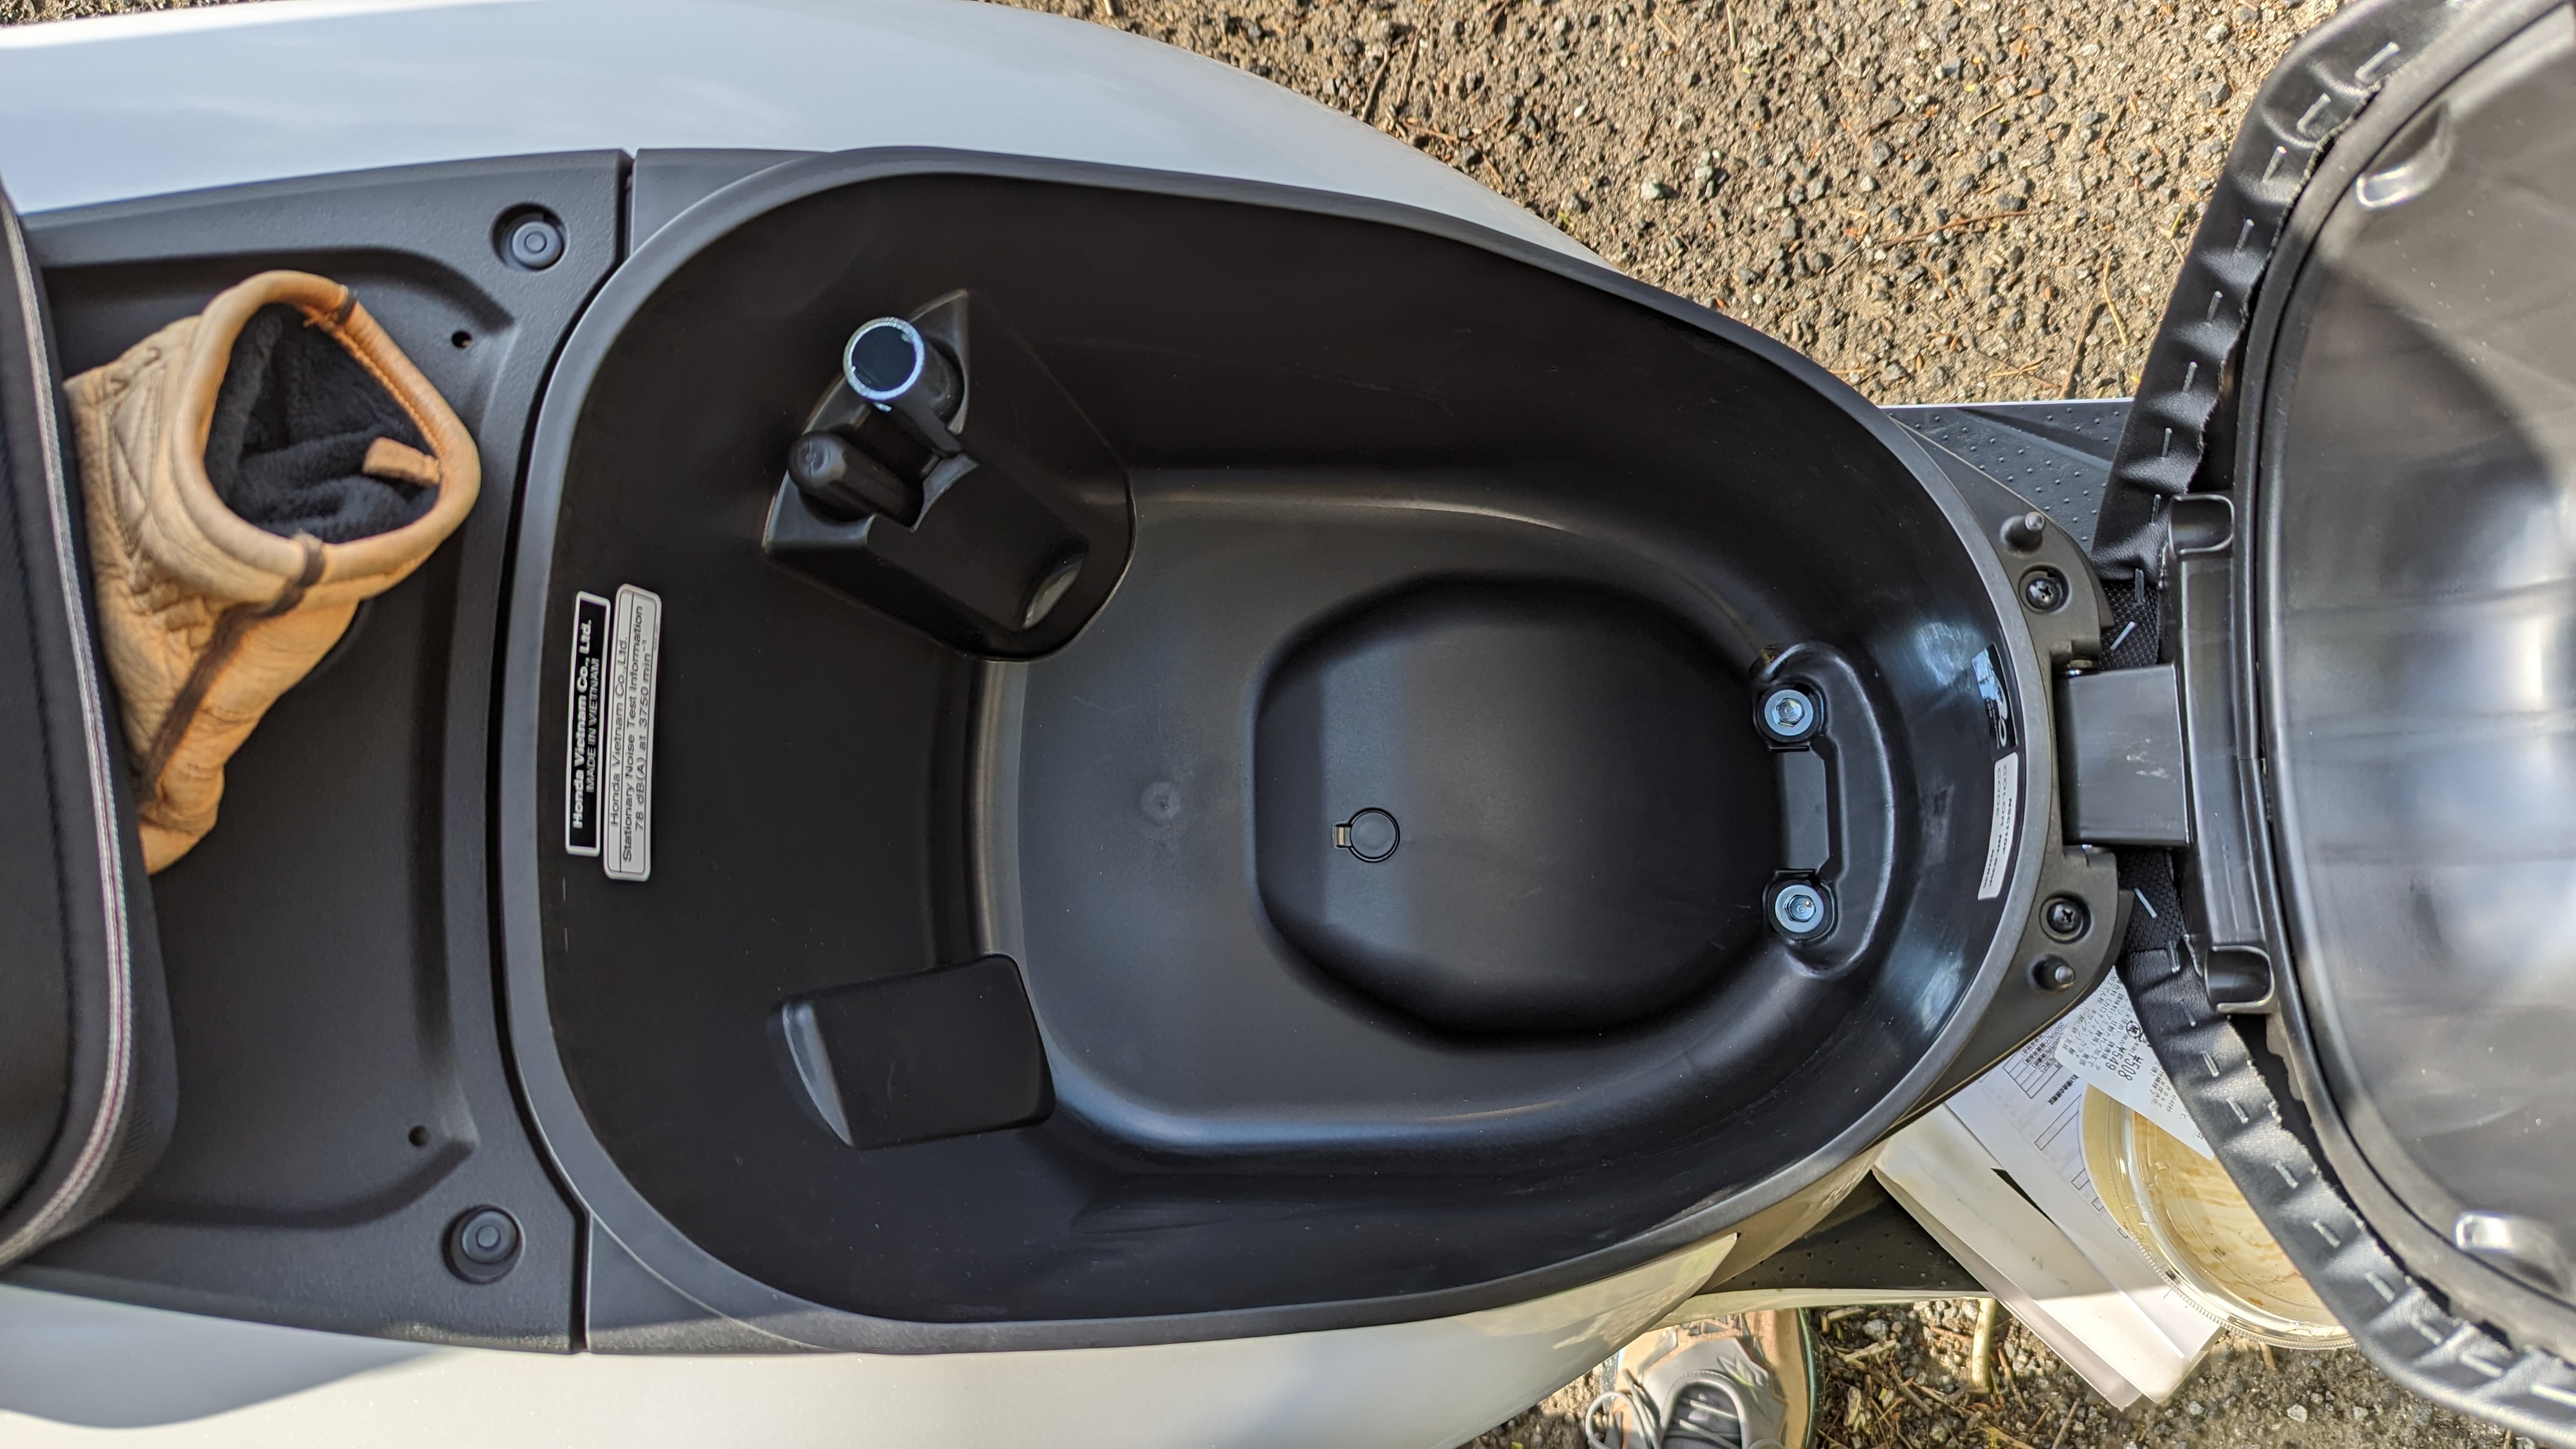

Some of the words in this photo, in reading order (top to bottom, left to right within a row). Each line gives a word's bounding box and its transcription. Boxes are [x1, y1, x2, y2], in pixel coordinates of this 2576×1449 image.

[579, 619, 592, 654] Ltd.
[629, 606, 643, 691] Information
[588, 658, 599, 726] VIETNAM
[627, 696, 637, 729] Test
[639, 686, 648, 727] 3750
[574, 696, 587, 767] Vietnam
[588, 728, 597, 745] IN
[612, 703, 624, 769] Vietnam
[637, 735, 646, 750] at
[586, 747, 596, 793] MADE
[625, 734, 634, 778] Noise
[572, 770, 584, 829] Honda
[610, 772, 620, 827] Honda
[635, 756, 647, 806] dB(A)
[623, 783, 635, 862] Stationary
[635, 811, 643, 831] 78
[2002, 797, 2012, 855] NSC110P
[2104, 1044, 2126, 1071] ¥549
[2116, 1051, 2144, 1082] ¥508
